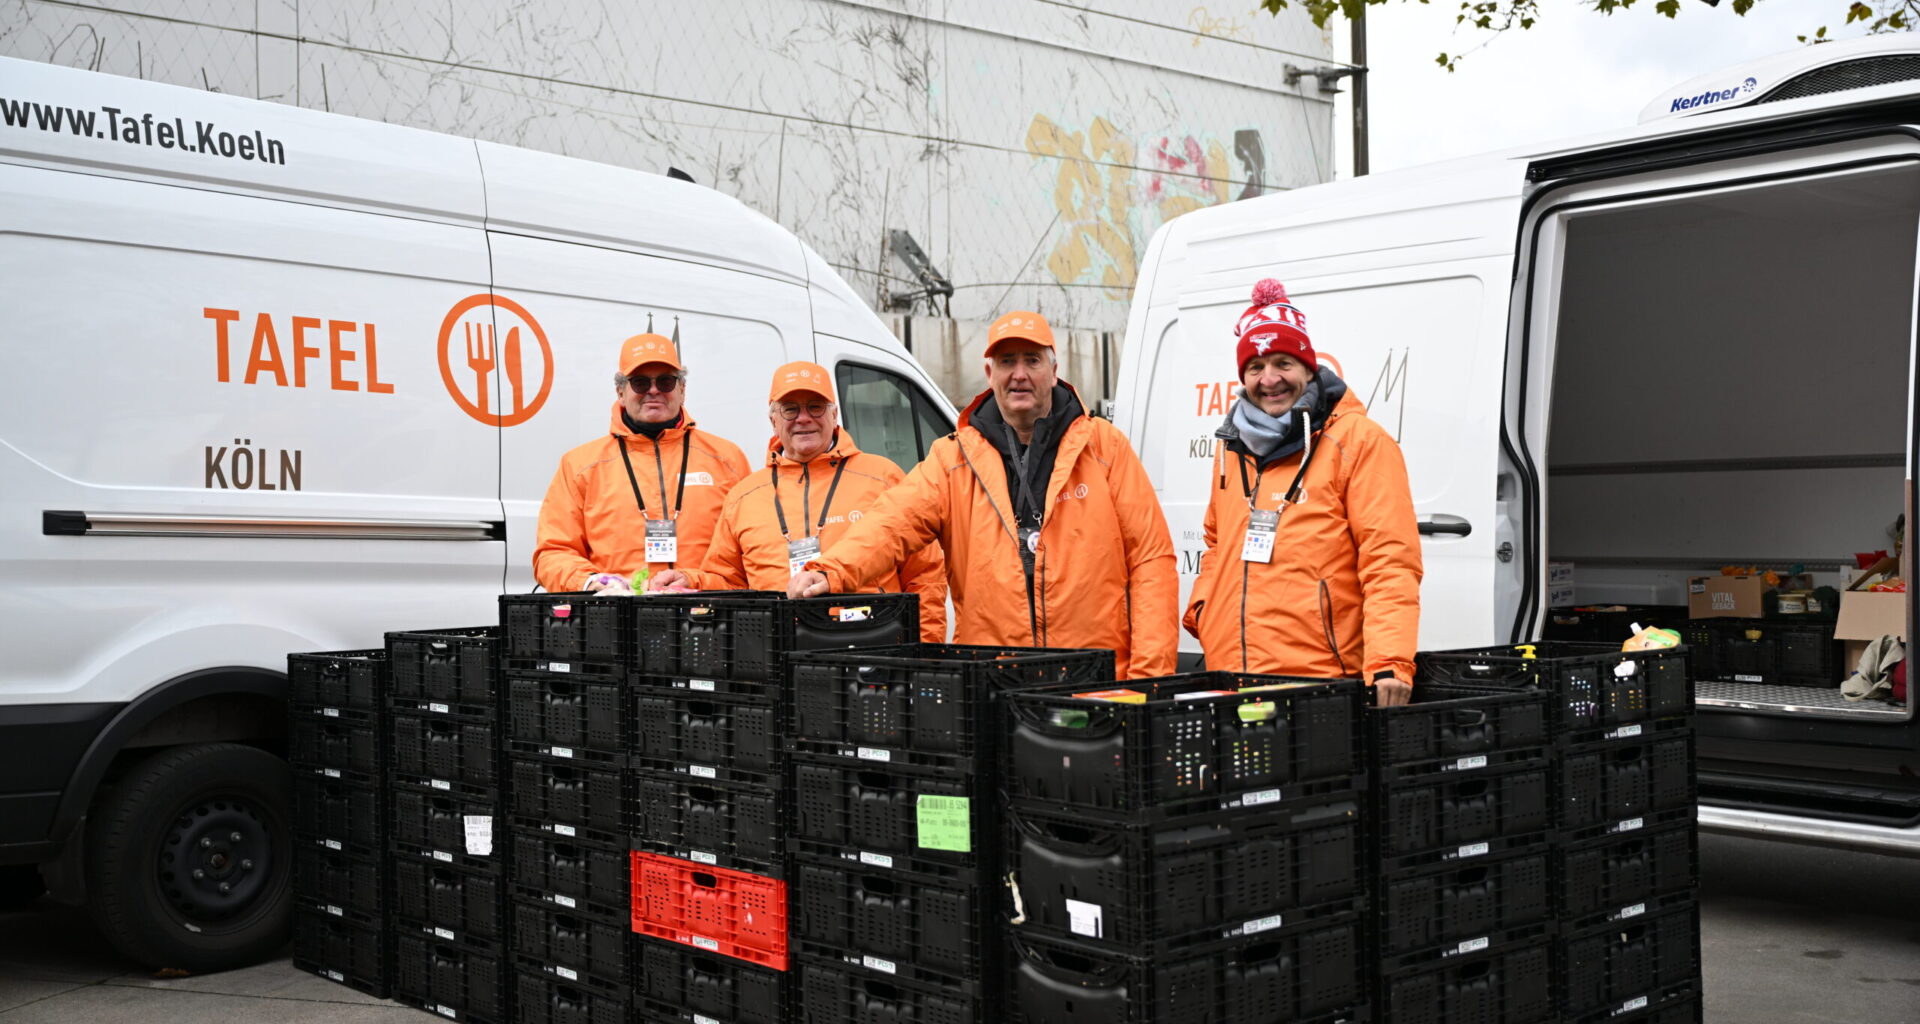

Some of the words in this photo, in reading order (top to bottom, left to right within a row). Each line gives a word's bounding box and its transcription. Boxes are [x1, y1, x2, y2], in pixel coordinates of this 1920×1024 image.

[1670, 86, 1740, 113] Kerstner
[0, 98, 286, 165] www.Tafel.Koeln
[203, 307, 395, 394] TAFEL
[1196, 381, 1239, 417] TAF
[205, 438, 303, 491] KÖLN
[1189, 435, 1215, 458] KÖL
[1712, 592, 1734, 603] VITAL
